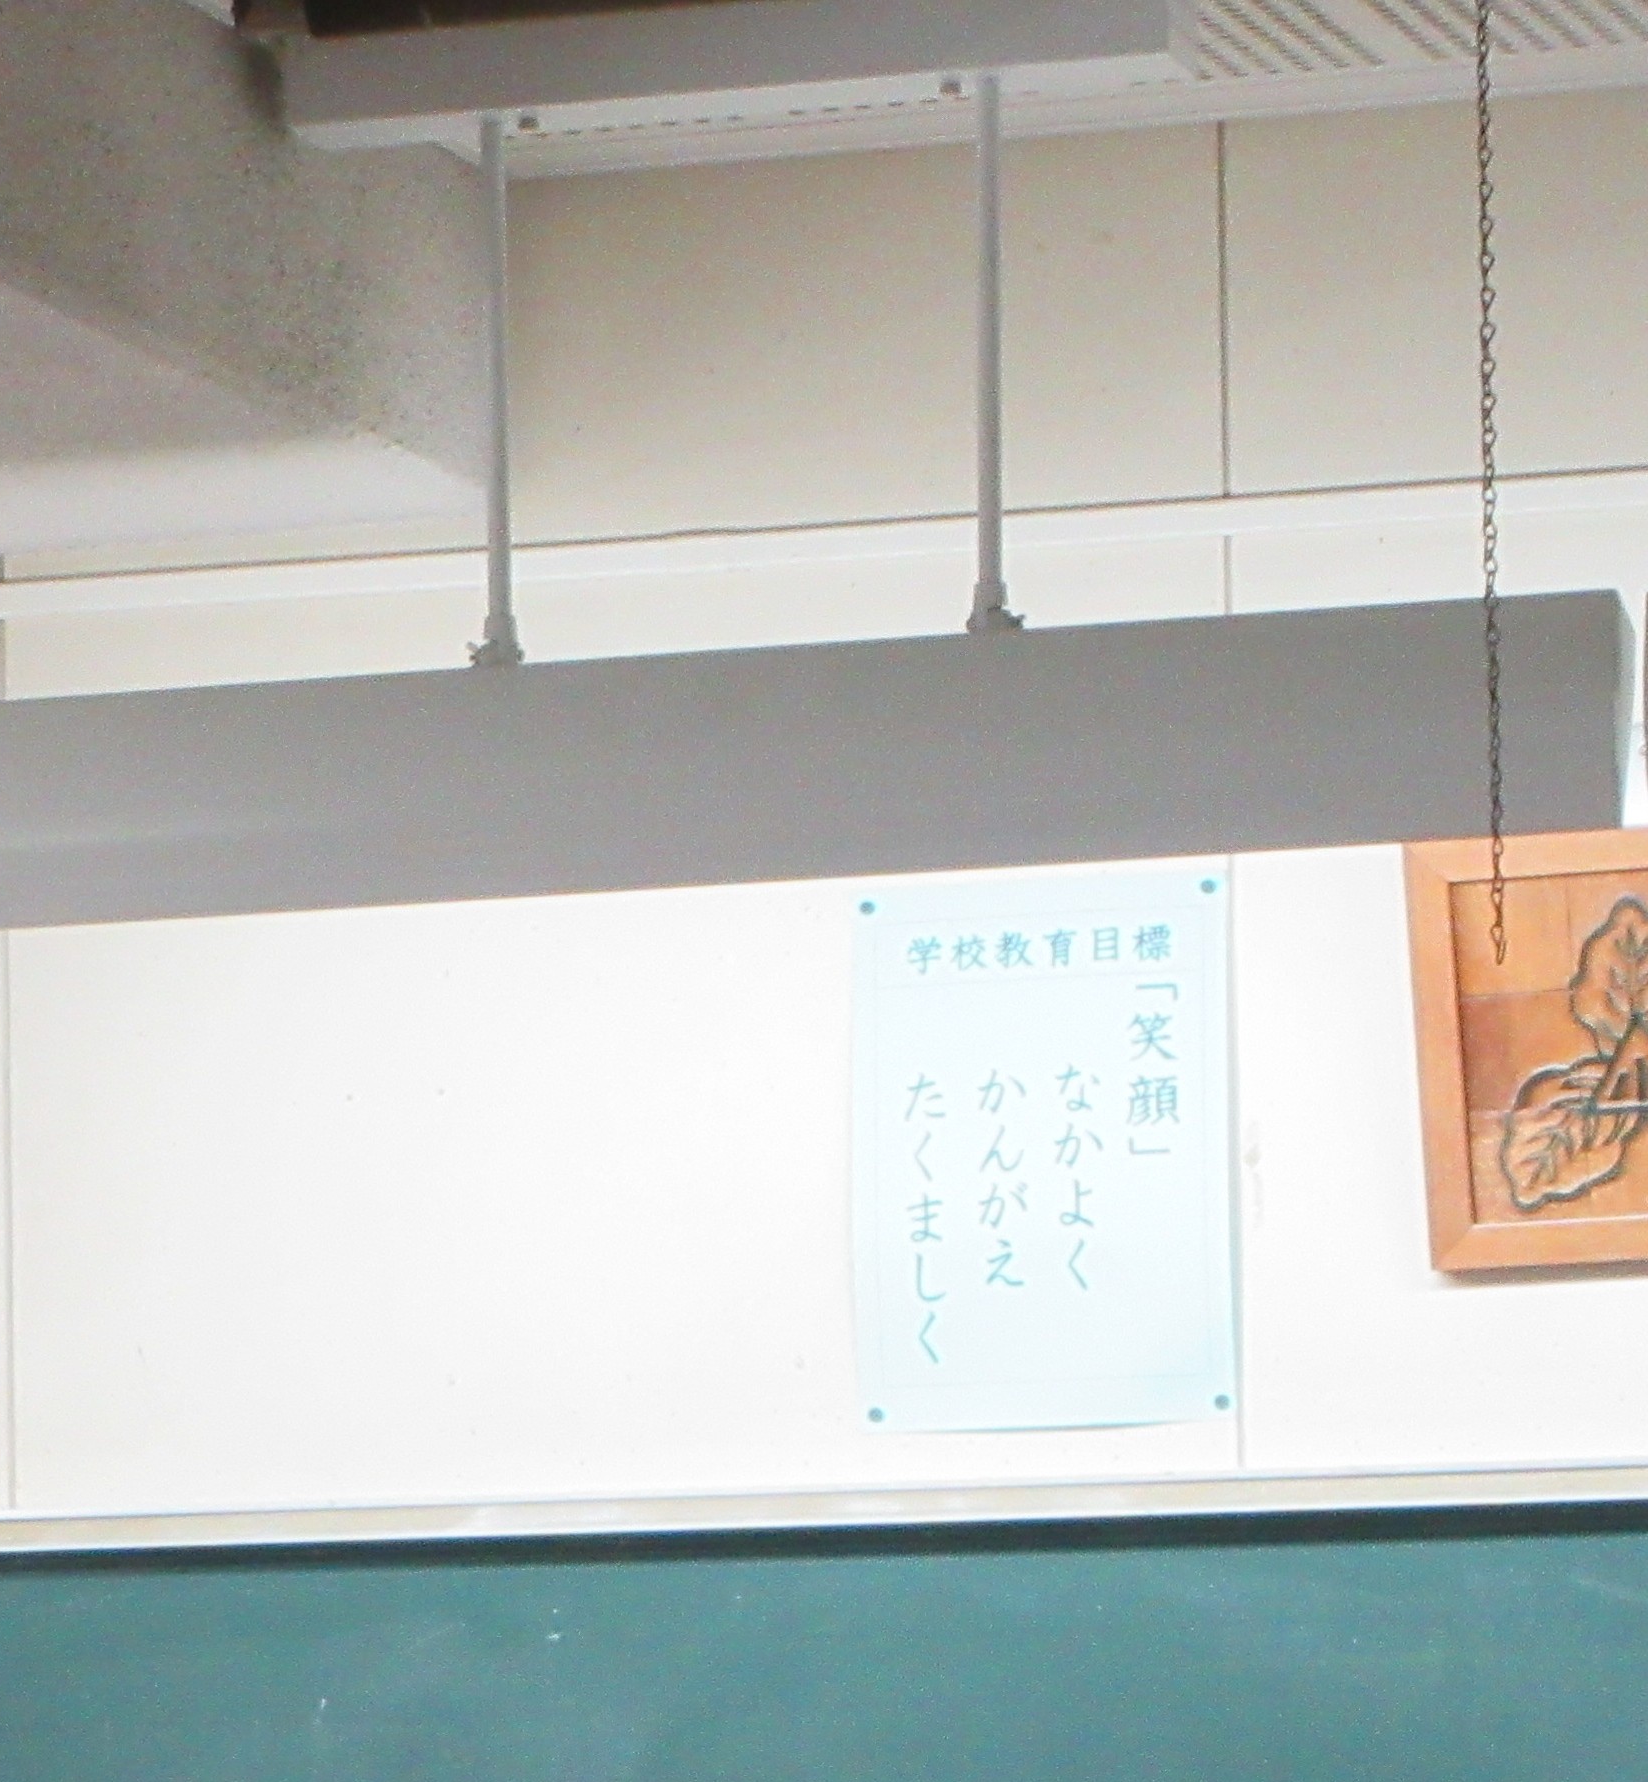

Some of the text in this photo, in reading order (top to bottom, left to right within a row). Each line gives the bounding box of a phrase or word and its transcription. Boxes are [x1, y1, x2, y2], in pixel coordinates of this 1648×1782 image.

[906, 922, 1172, 975] 学校教育目標
[1053, 1062, 1104, 1292] なかよく
[1125, 979, 1181, 1156] 「笑顔」
[903, 1071, 948, 1365] たくましく
[976, 1069, 1029, 1290] かんがえ
